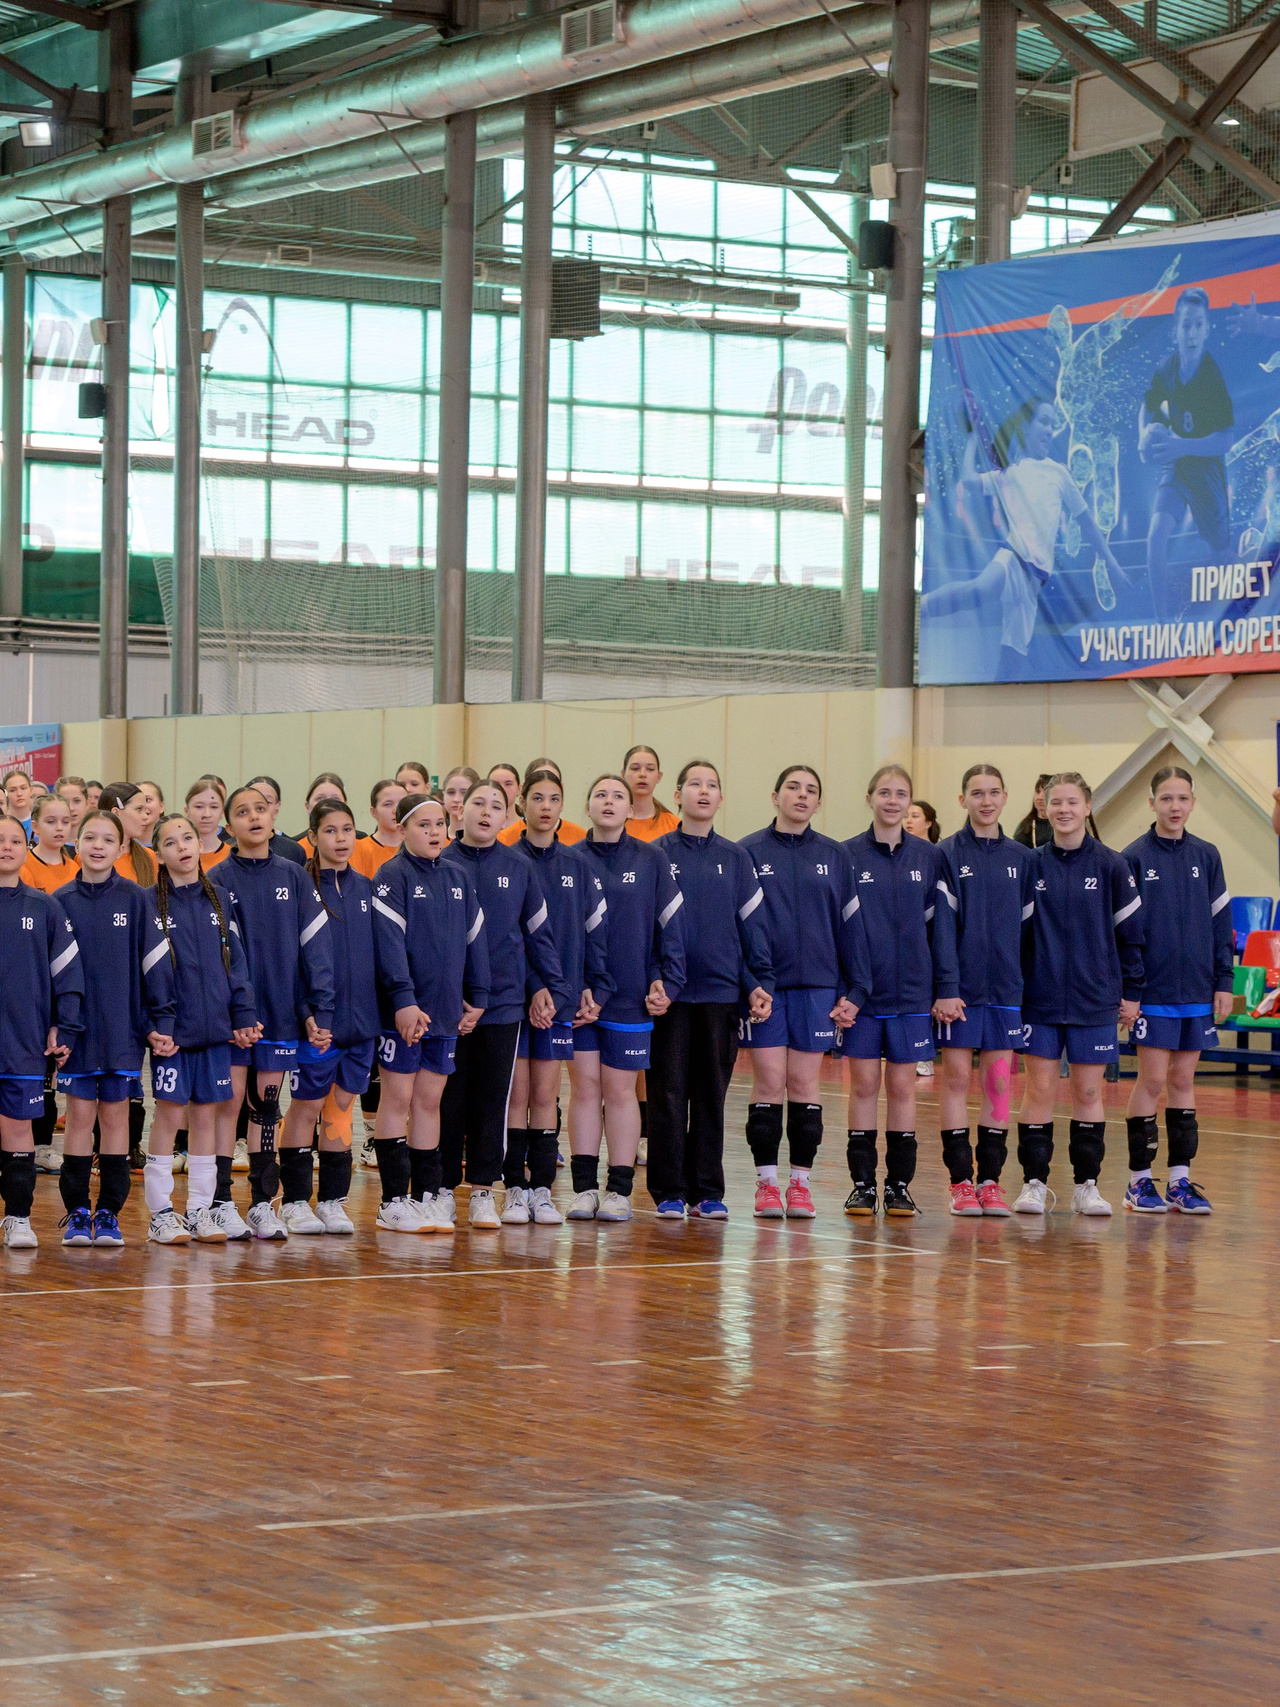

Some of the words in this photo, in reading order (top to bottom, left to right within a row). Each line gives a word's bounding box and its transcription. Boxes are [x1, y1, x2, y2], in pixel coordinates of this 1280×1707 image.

[207, 409, 375, 446] HEAD
[1191, 560, 1273, 603] ПРИВЕТ
[1080, 620, 1216, 662] УЧАСТНИКАМ
[717, 864, 722, 875] 1
[816, 863, 828, 876] 31
[910, 870, 922, 882] 16
[1007, 866, 1017, 879] 11
[1192, 866, 1200, 878] 3
[497, 876, 509, 888] 19
[561, 875, 574, 888] 28
[622, 871, 635, 883] 25
[1084, 877, 1098, 890] 22
[276, 887, 289, 900] 23
[451, 887, 463, 900] 29
[360, 899, 367, 912] 5
[21, 916, 34, 930] 18
[113, 913, 127, 927] 35
[738, 1017, 753, 1041] 31
[937, 1020, 952, 1041] 11
[1135, 1017, 1148, 1040] 3
[155, 1065, 179, 1093] 33
[289, 1069, 300, 1091] 5
